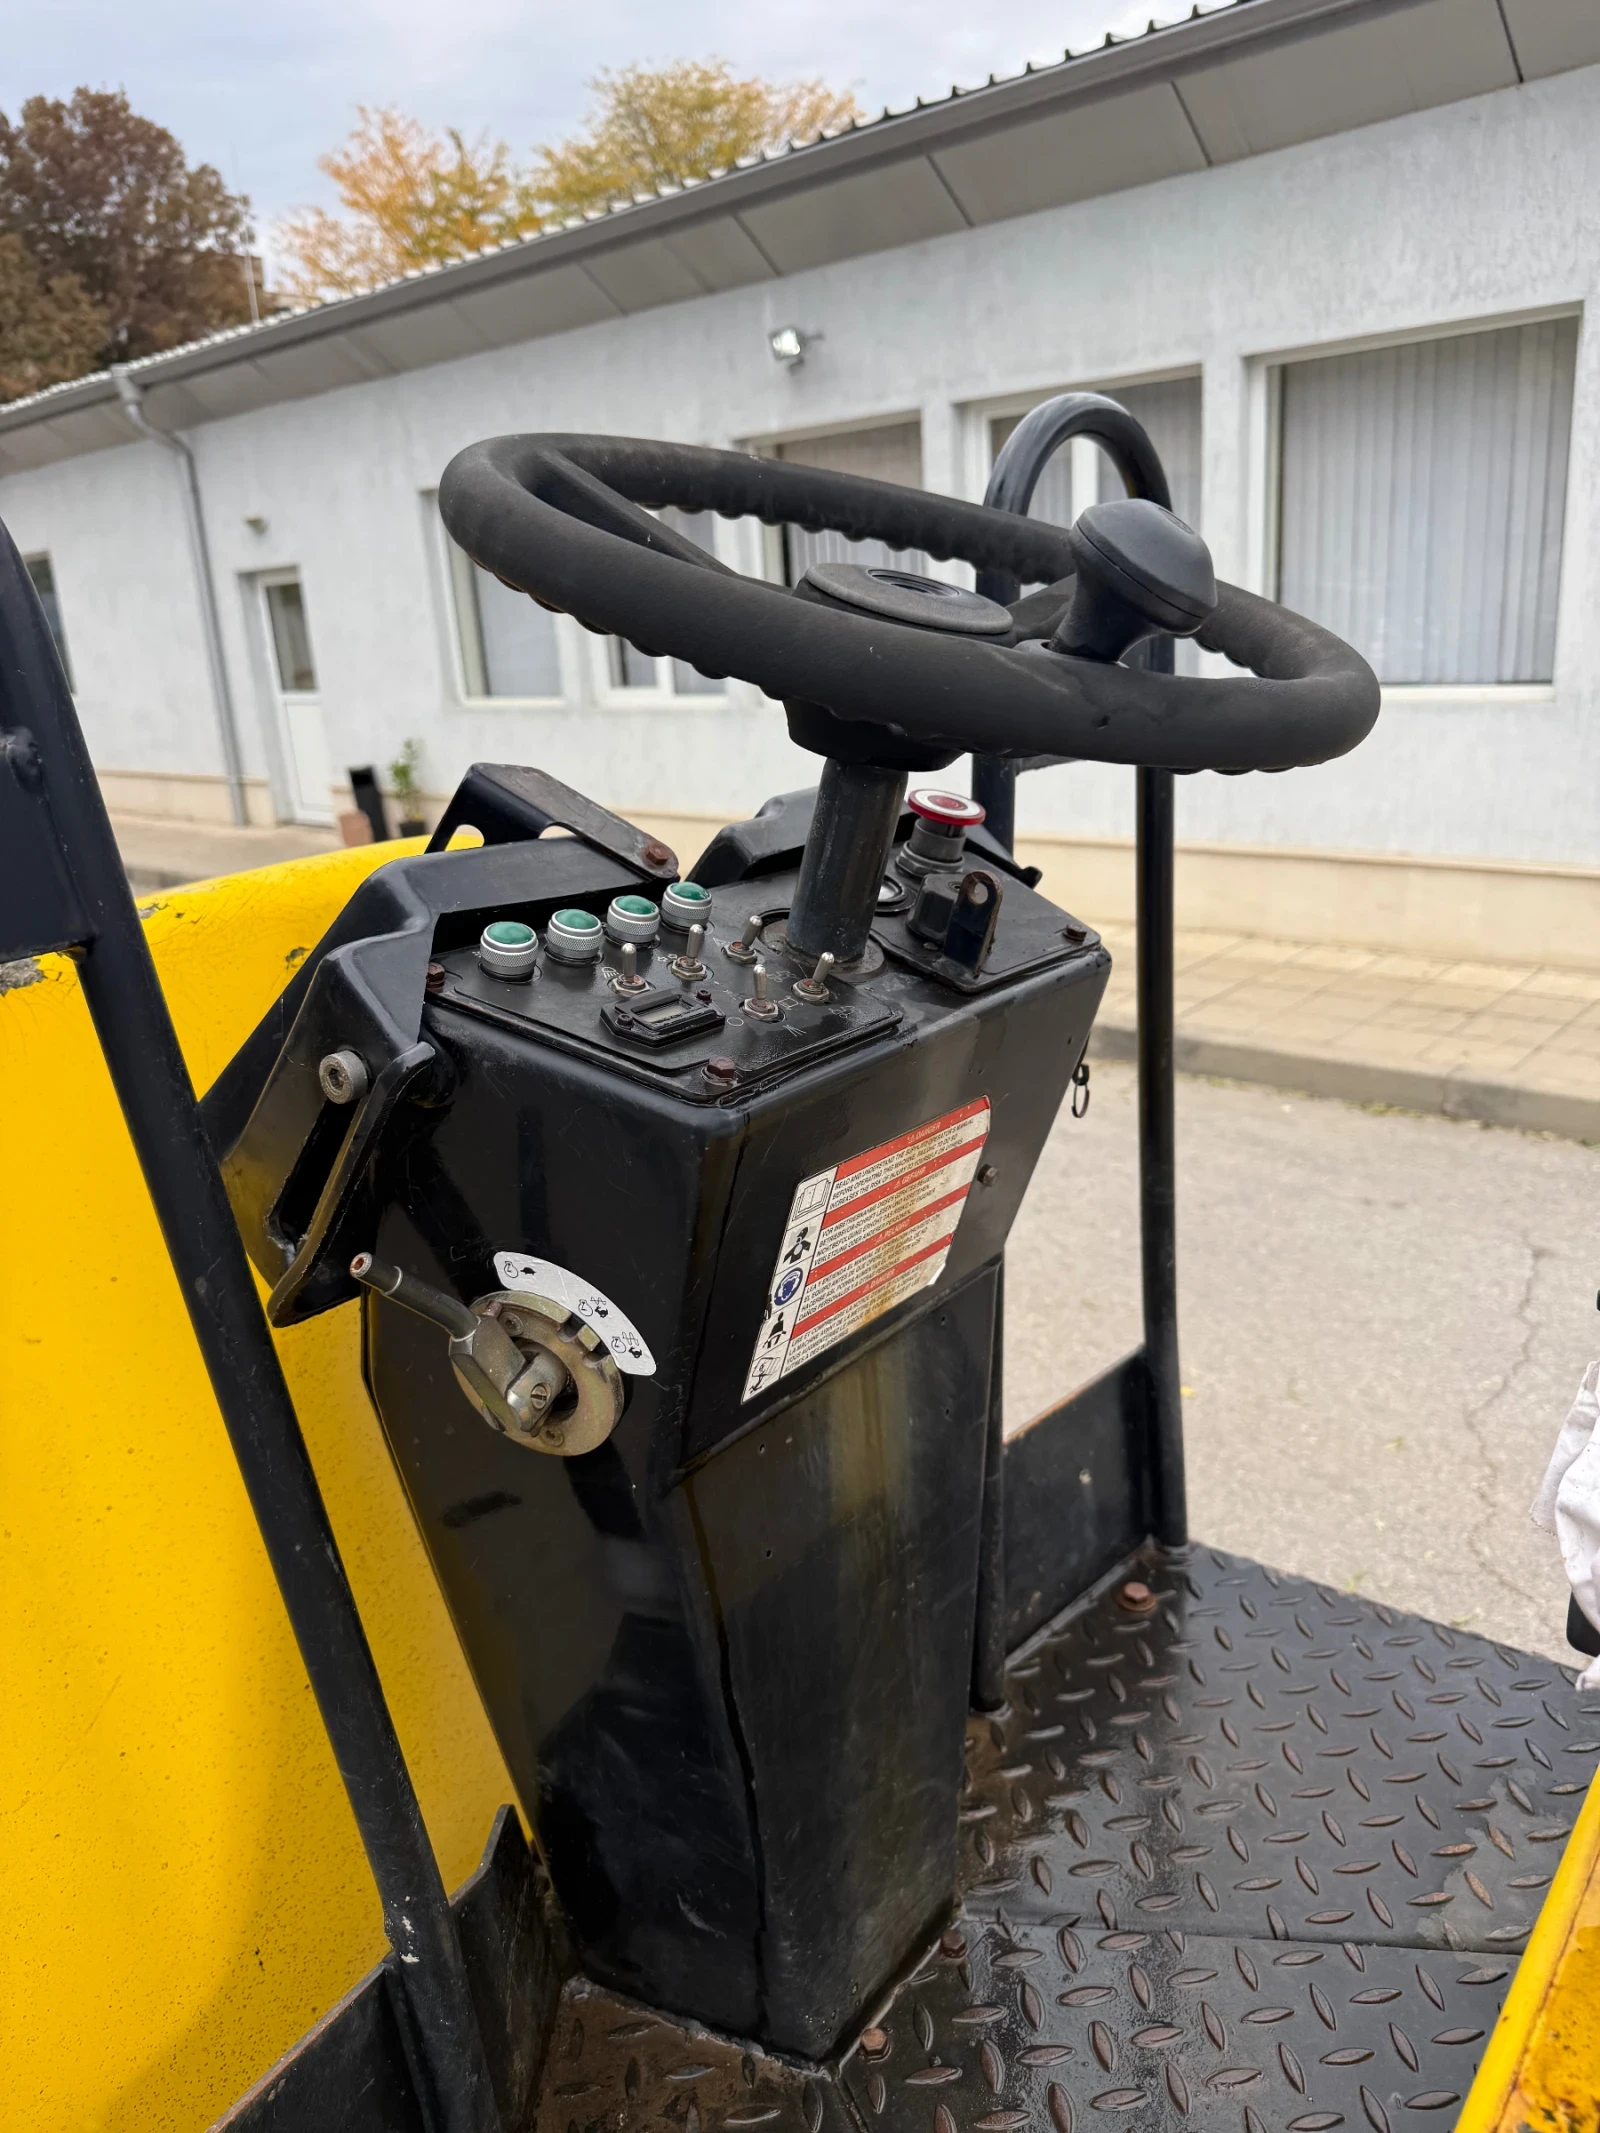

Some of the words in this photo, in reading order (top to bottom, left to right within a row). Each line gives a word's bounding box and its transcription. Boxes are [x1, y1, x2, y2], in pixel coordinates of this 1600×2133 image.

[915, 1121, 941, 1140] DANGER
[900, 1165, 926, 1184] GEFAHR
[832, 1183, 853, 1200] BEFORE
[884, 1217, 910, 1238] PELIGRO
[869, 1267, 895, 1288] DANGER
